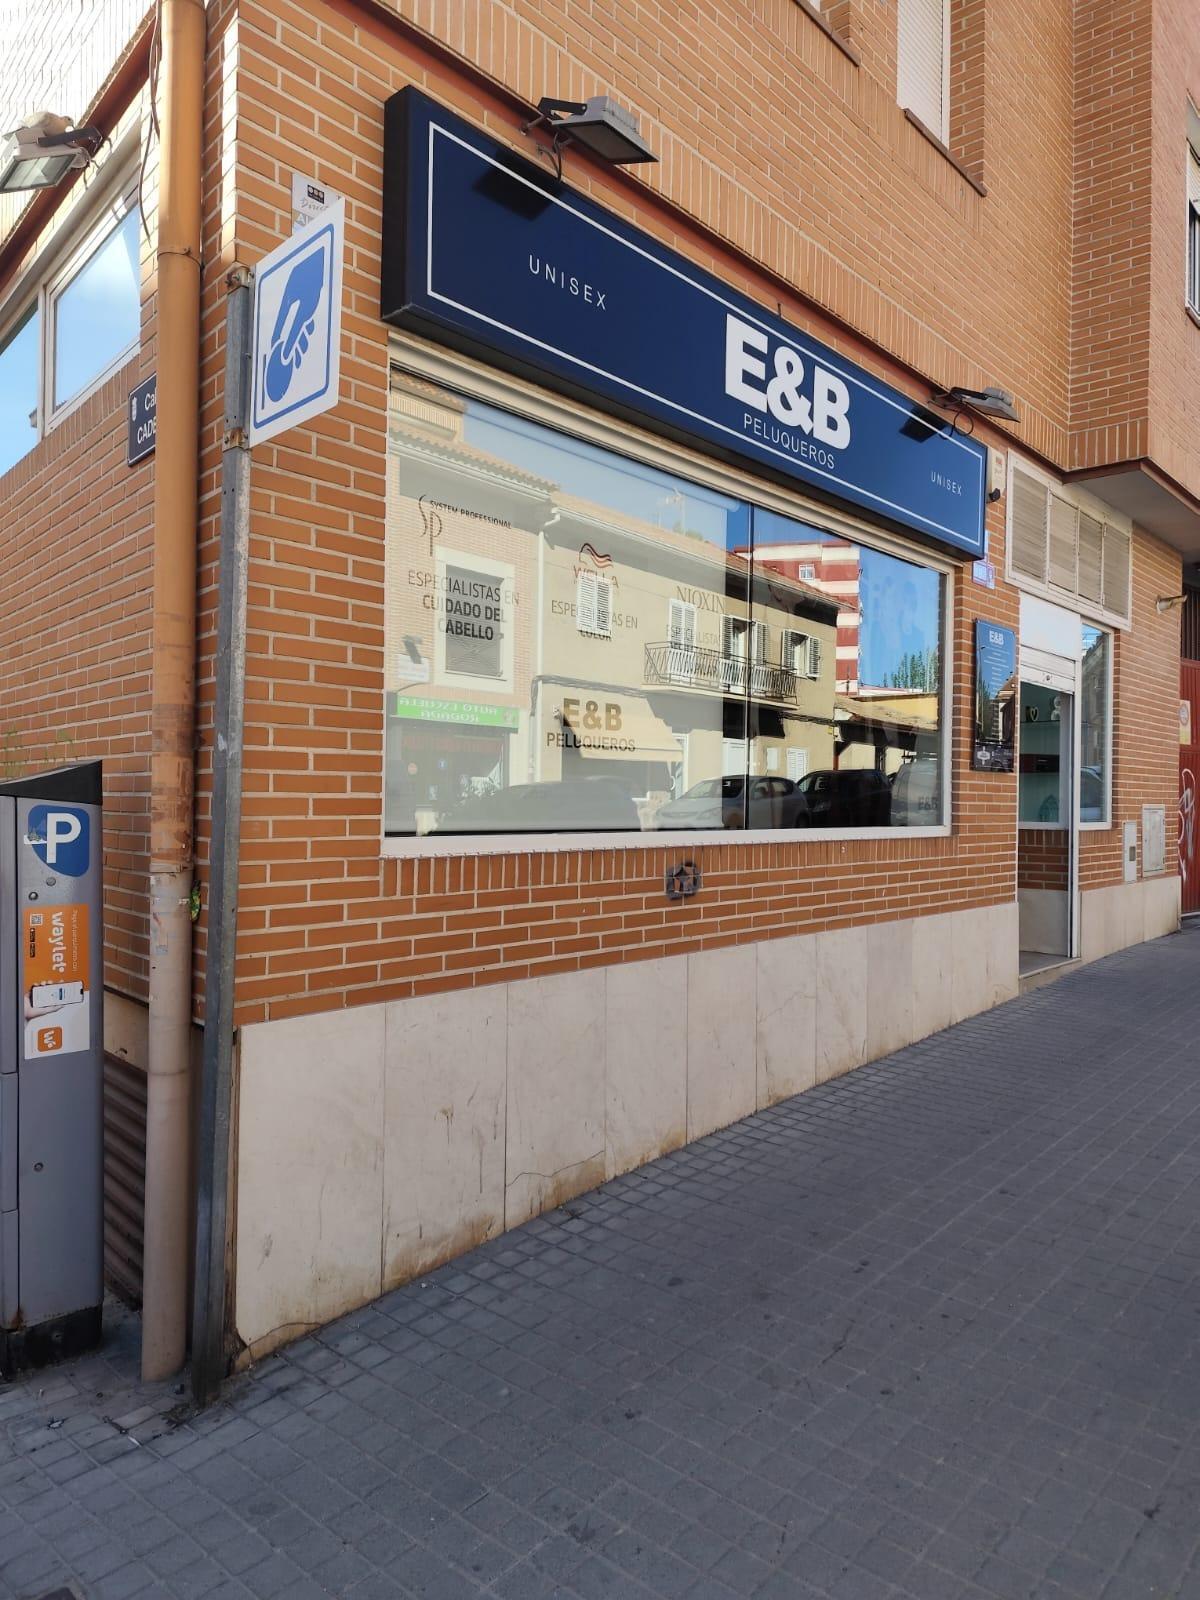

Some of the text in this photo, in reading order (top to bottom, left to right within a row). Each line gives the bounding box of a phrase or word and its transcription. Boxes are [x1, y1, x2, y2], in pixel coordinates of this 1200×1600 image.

[529, 254, 606, 310] UNISEX
[725, 313, 851, 450] E&B
[744, 413, 835, 469] PELUQUEROS
[931, 471, 962, 496] UNISEX
[430, 500, 512, 529] SYSTEM PROFESSIONAL
[408, 570, 501, 602] ESPECIALISTAS
[677, 586, 725, 614] NIOXIN
[422, 595, 506, 622] CUIDADO DEL
[438, 618, 494, 641] CABELLO
[563, 698, 622, 731] E&B
[547, 732, 635, 752] PELUQUEROS
[46, 813, 81, 864] P
[48, 911, 67, 973] waylet
